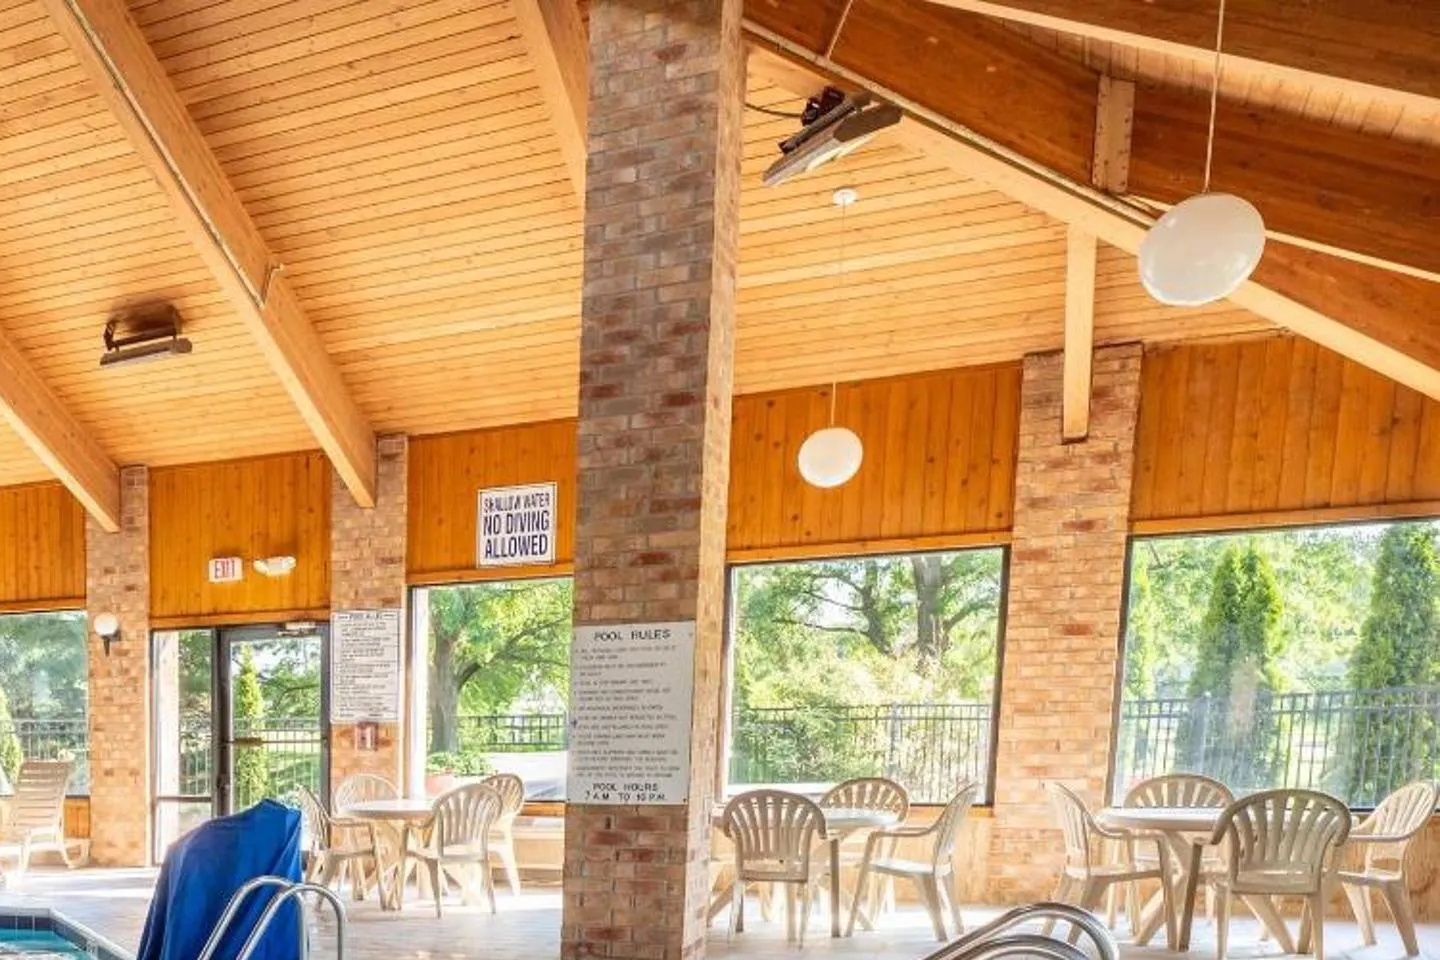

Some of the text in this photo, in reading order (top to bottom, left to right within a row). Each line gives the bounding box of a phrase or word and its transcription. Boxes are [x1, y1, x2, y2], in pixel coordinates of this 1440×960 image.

[524, 492, 550, 509] WATER
[483, 510, 550, 536] NO DIVING
[485, 533, 548, 558] ALLOWED
[214, 559, 235, 579] EXIT
[594, 628, 671, 641] POOL RULES
[593, 782, 658, 792] POOL HOURS
